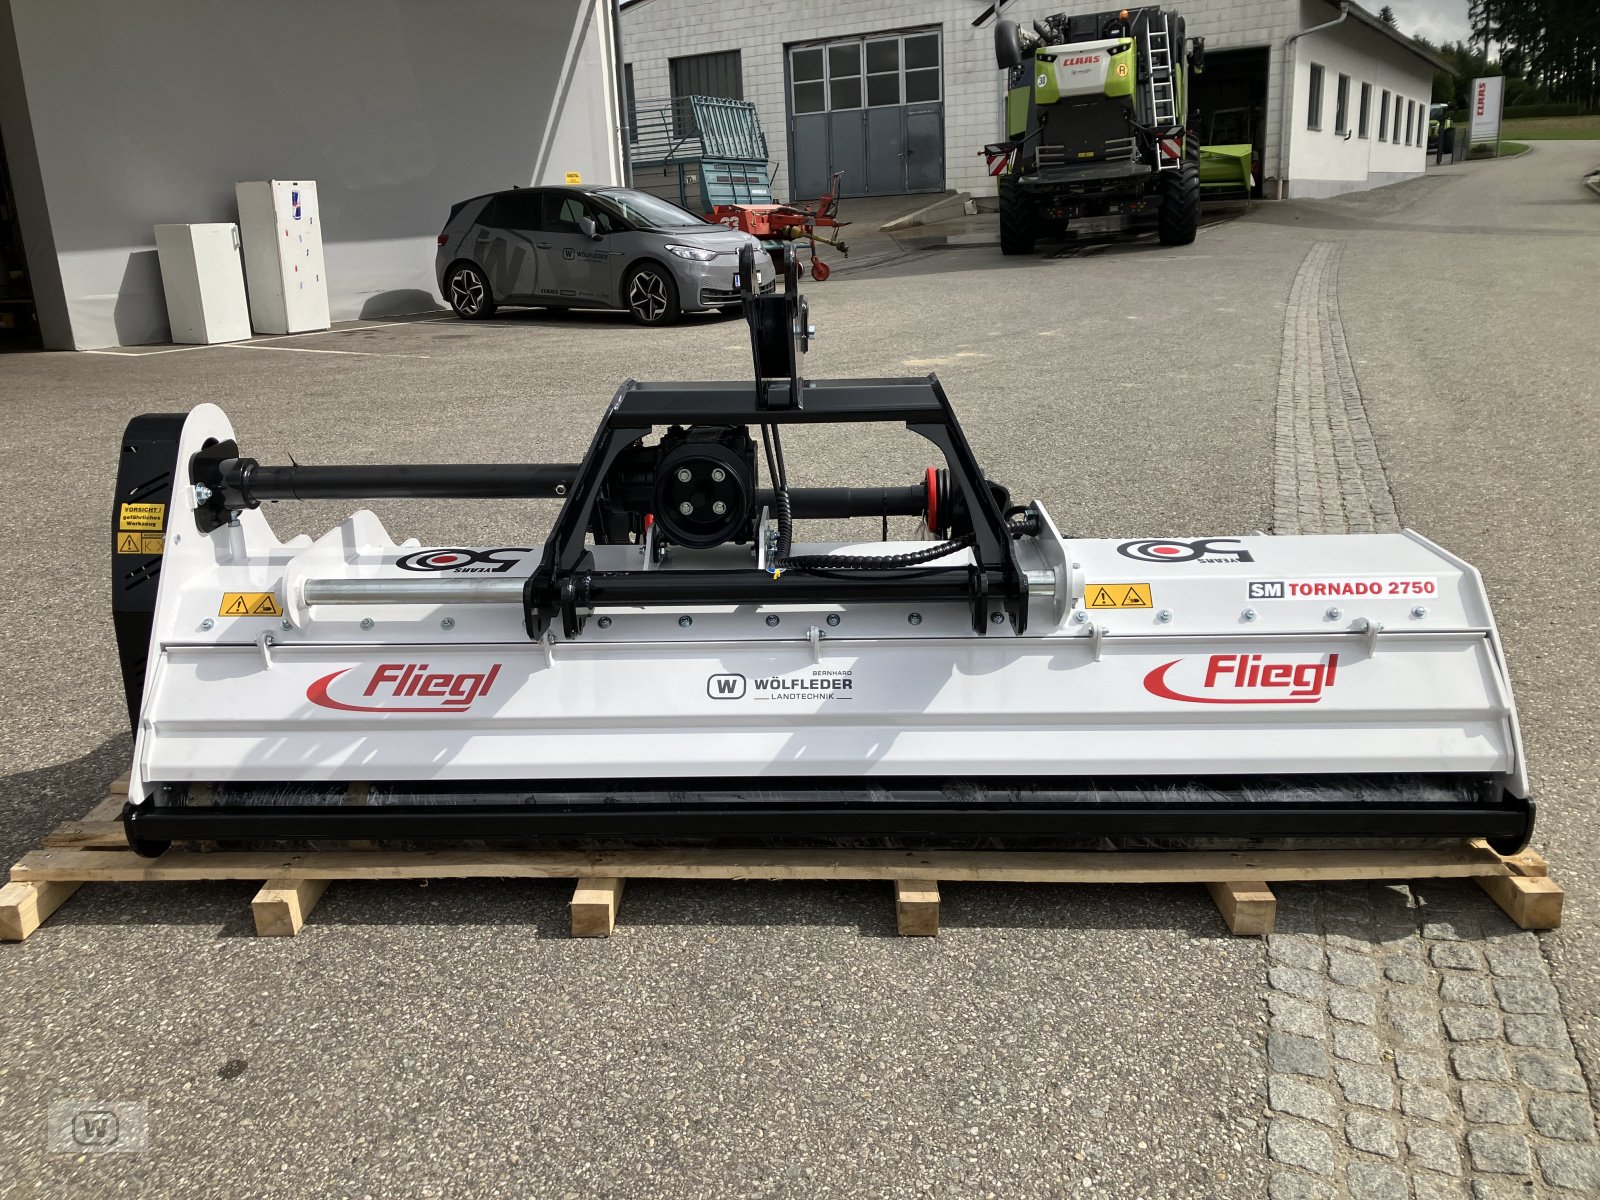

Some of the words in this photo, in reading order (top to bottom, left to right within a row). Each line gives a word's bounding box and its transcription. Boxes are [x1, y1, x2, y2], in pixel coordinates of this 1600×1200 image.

[1063, 56, 1102, 67] CLAAS
[1038, 75, 1046, 86] 30
[1476, 82, 1486, 116] CLAAS
[1251, 583, 1282, 597] SM
[1288, 582, 1383, 596] TORNADO
[1388, 581, 1435, 595] 2750
[1203, 653, 1339, 696] Fliegl
[362, 663, 502, 705] Fliegl
[754, 676, 853, 690] WÖLFLEDER
